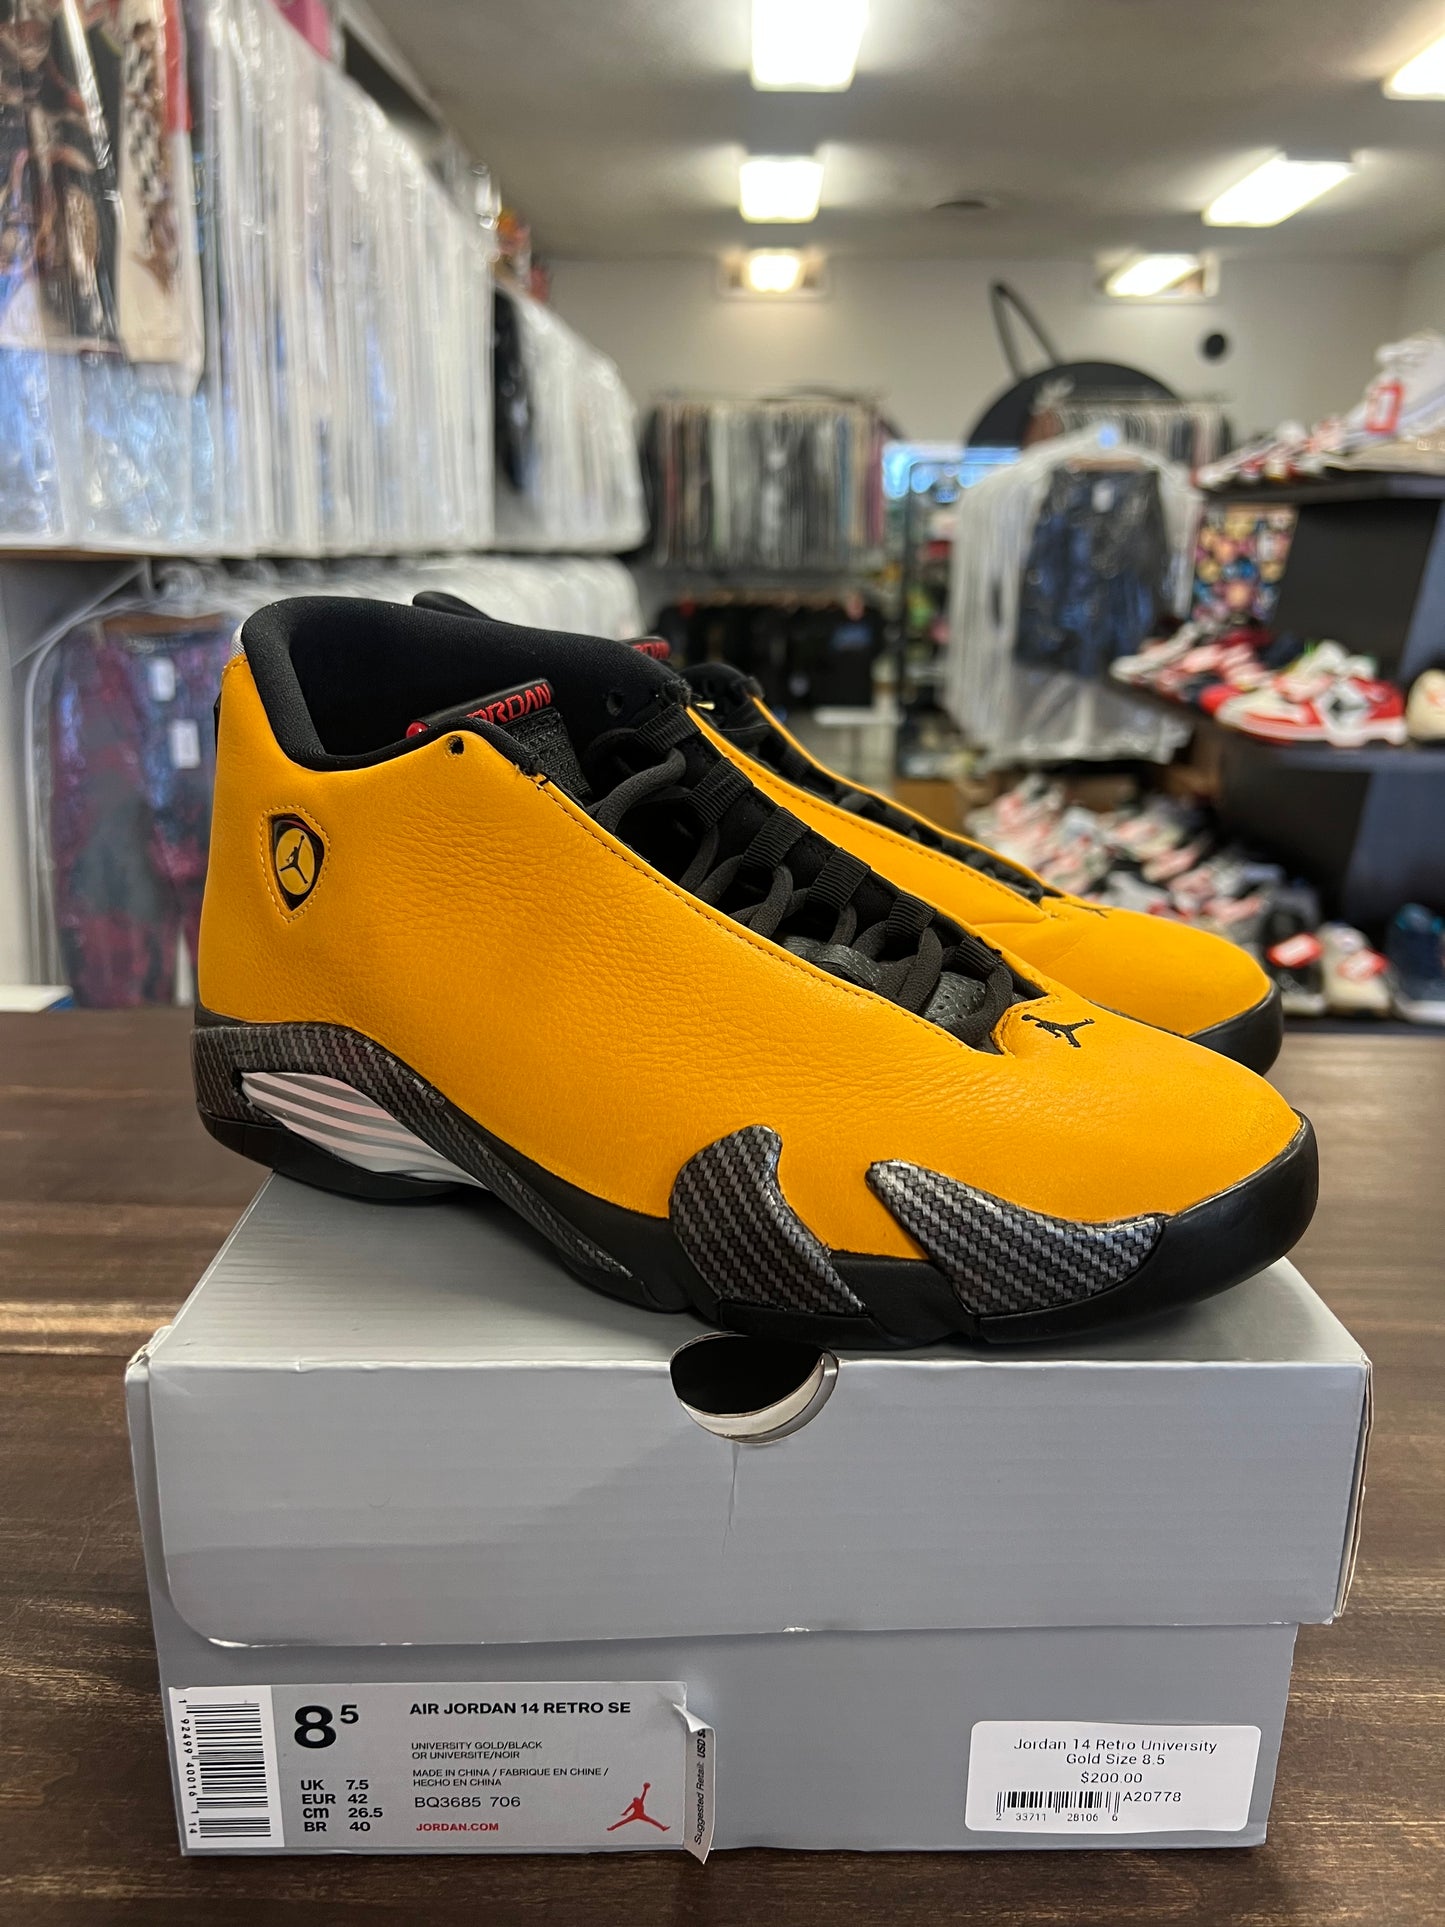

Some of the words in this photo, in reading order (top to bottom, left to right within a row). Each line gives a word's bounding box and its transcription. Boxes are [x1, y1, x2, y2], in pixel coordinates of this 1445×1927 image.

[466, 682, 551, 726] RDAN
[410, 1703, 439, 1715] AIR
[444, 1702, 516, 1715] JORDAN
[521, 1702, 539, 1714] 14
[544, 1702, 603, 1714] RETRO
[608, 1702, 631, 1714] SE
[411, 1741, 472, 1751] UNIVERSITY
[474, 1741, 543, 1751] GOLD/BLACK
[697, 1739, 706, 1758] USD
[1013, 1738, 1067, 1751] Jordan
[1073, 1738, 1091, 1750] 14
[1096, 1739, 1136, 1751] Retro
[1140, 1739, 1217, 1755] University
[412, 1751, 427, 1760] OR
[429, 1751, 520, 1760] UNIVERSITE/NOIR
[1066, 1752, 1101, 1765] Gold
[1105, 1753, 1137, 1765] Size
[1141, 1754, 1166, 1765] 8.5
[412, 1769, 443, 1778] MADE
[445, 1769, 455, 1777] IN
[458, 1769, 490, 1778] CHINA
[500, 1768, 550, 1777] FABRIQUE
[553, 1768, 568, 1776] EN
[570, 1768, 602, 1777] CHINE
[1080, 1771, 1143, 1785] $200.00
[300, 1779, 324, 1791] UK
[346, 1779, 369, 1791] 7.5
[413, 1779, 451, 1787] HECHO
[453, 1779, 467, 1787] EN
[469, 1779, 502, 1787] CHINA
[302, 1794, 336, 1805] EUR
[347, 1793, 368, 1805] 42
[414, 1796, 481, 1808] BQ3685
[489, 1796, 521, 1808] 706
[1122, 1791, 1182, 1803] A20778
[303, 1807, 329, 1819] cm
[348, 1807, 383, 1818] 26.5
[995, 1812, 1002, 1822] 2
[1015, 1812, 1047, 1822] 33711
[1067, 1812, 1099, 1822] 28106
[1111, 1813, 1118, 1822] 6
[693, 1794, 706, 1846] Suggested
[304, 1821, 327, 1832] BR
[349, 1821, 371, 1832] 40
[416, 1823, 499, 1832] JORDAN.COM
